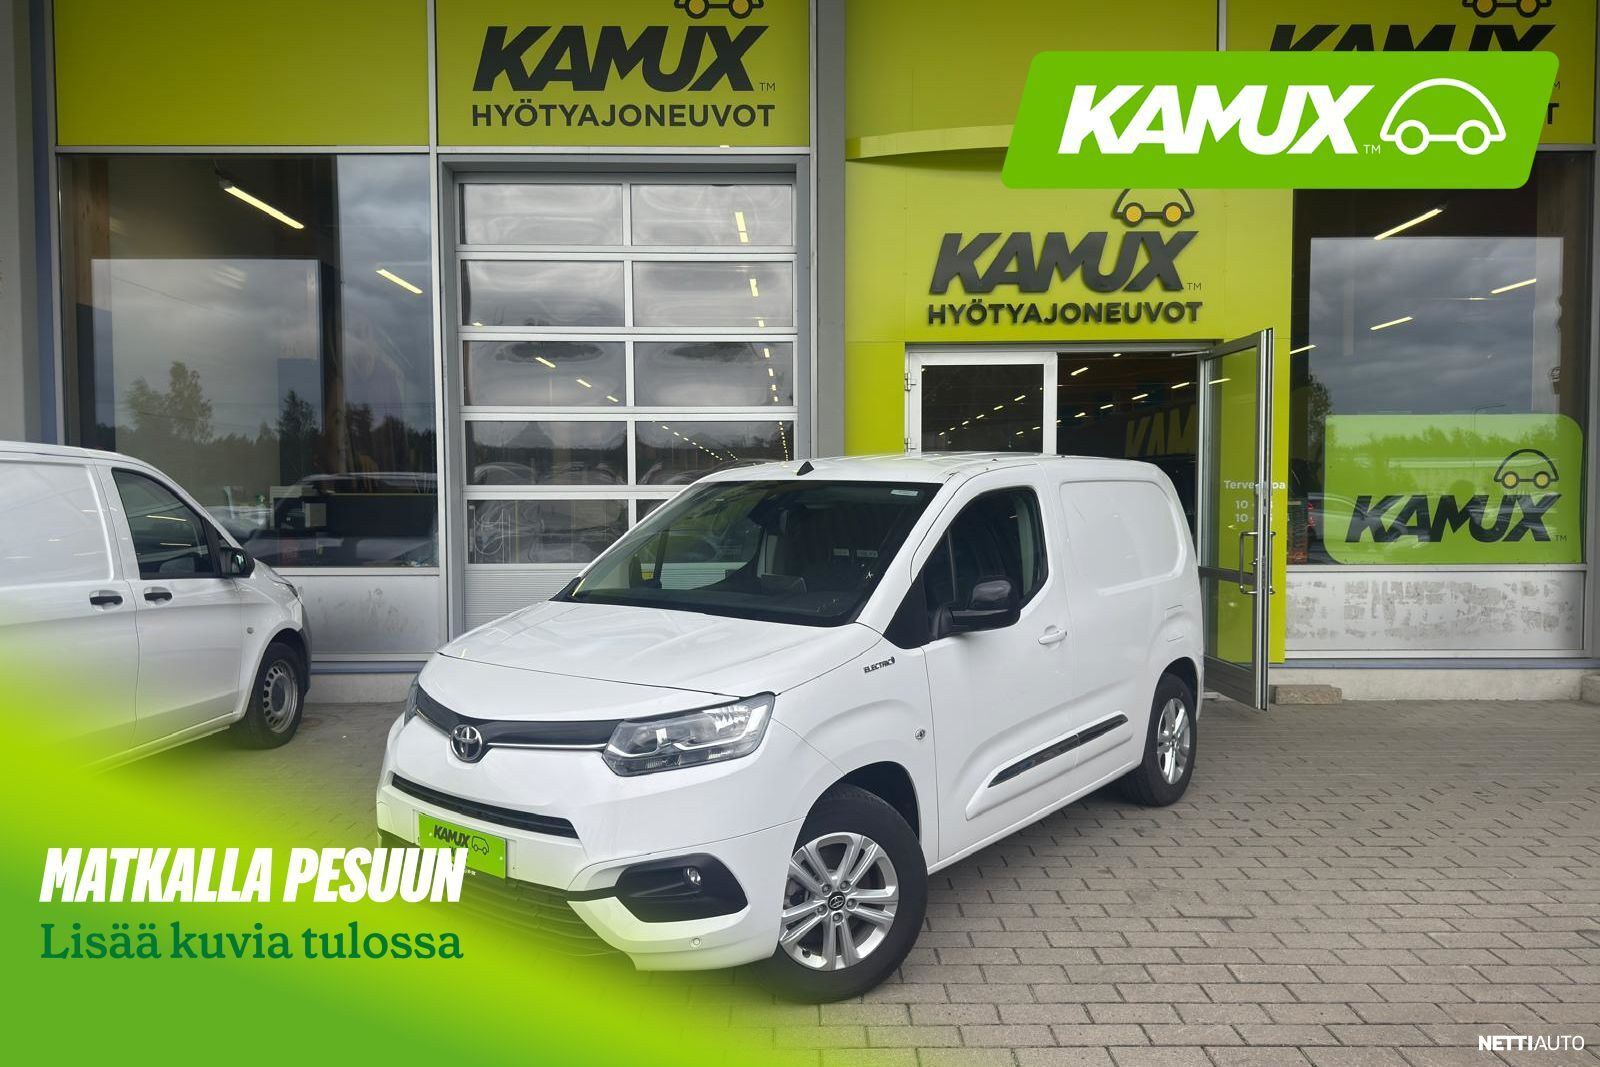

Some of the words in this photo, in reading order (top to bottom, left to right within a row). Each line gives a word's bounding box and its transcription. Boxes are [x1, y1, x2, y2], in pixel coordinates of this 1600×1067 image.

[472, 25, 769, 92] KAMUX
[472, 99, 775, 127] HYÖTYAJONEUVOT
[928, 231, 1199, 295] KAMUX
[928, 298, 1203, 325] HYÖTYAJONEUVOT
[1224, 480, 1286, 490] Terveoa
[1345, 493, 1562, 543] KAMUX
